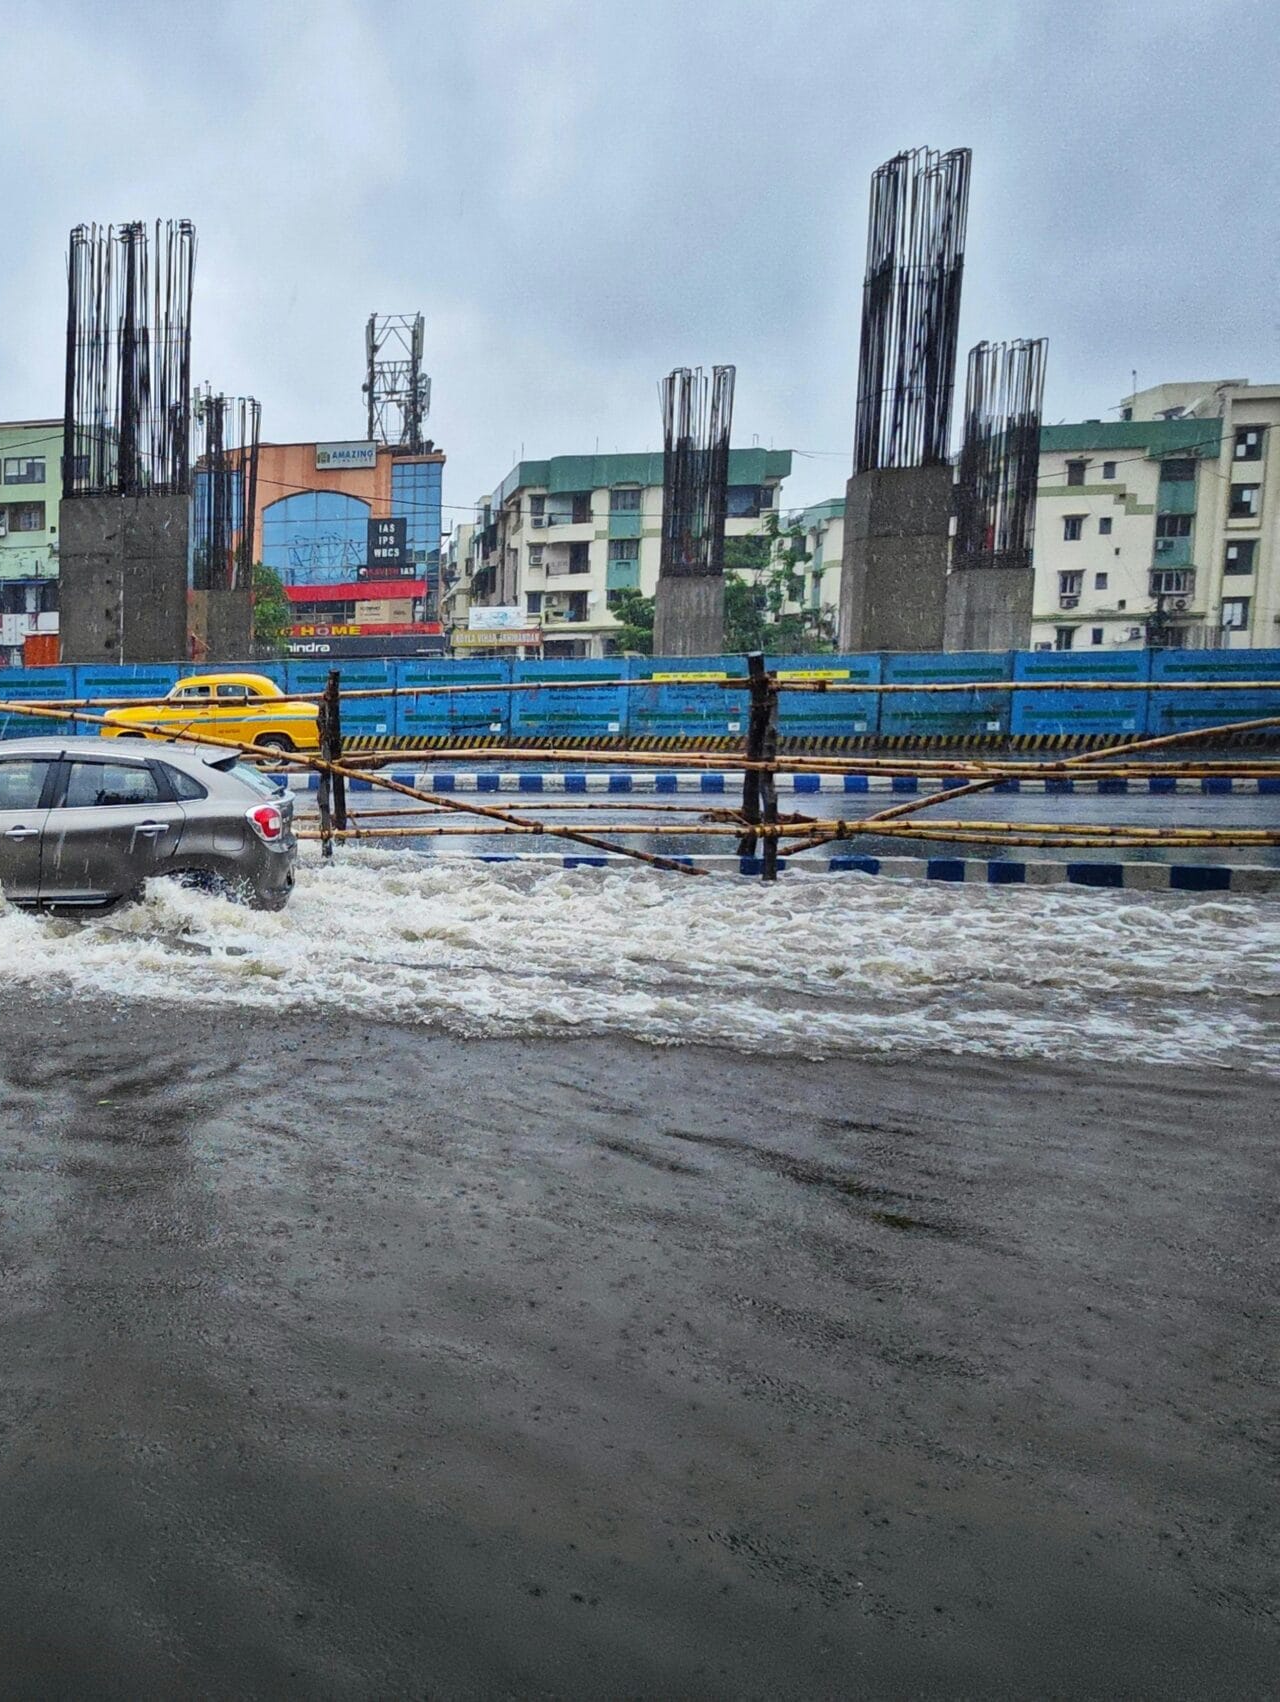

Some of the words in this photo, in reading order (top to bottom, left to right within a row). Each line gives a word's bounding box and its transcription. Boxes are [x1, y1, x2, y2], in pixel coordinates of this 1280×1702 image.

[332, 449, 373, 459] AMAZING
[379, 524, 395, 533] IAS
[379, 536, 394, 545] IPS
[374, 548, 400, 557] WBCS
[400, 567, 415, 575] IAS
[300, 625, 361, 636] HOME
[276, 642, 330, 653] hindra
